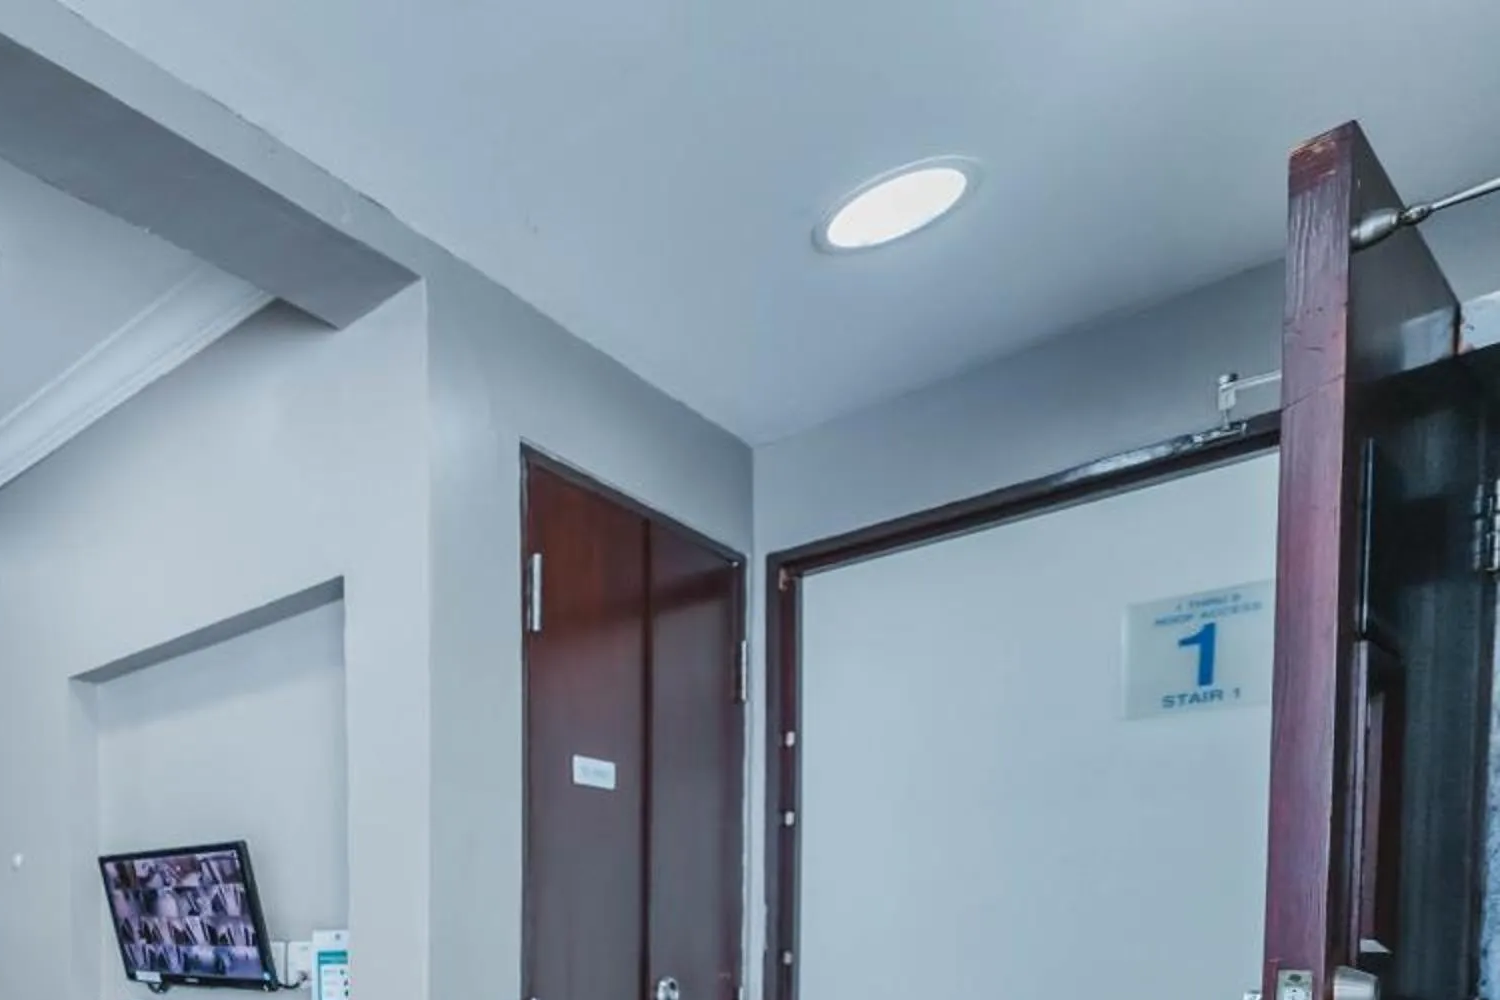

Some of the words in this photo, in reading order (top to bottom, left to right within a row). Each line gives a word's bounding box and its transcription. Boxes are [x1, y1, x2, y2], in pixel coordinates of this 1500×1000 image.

[1177, 620, 1216, 687] 1
[1161, 688, 1224, 709] STAIR
[1232, 686, 1241, 699] 1
